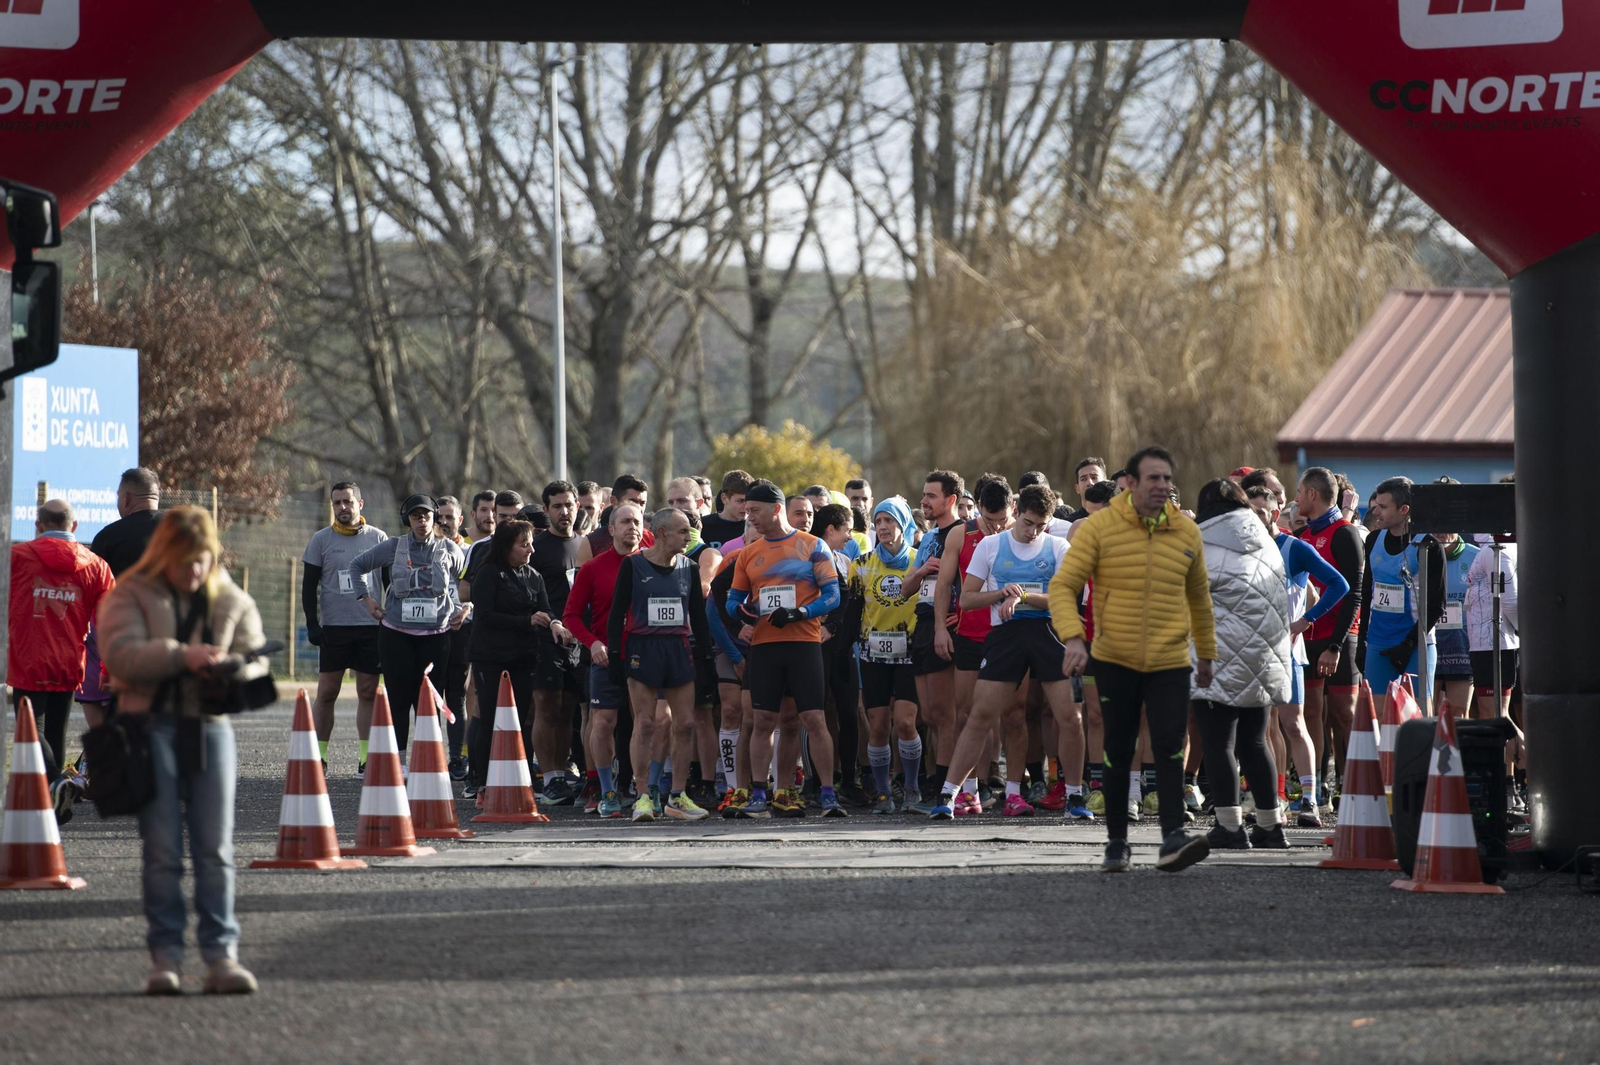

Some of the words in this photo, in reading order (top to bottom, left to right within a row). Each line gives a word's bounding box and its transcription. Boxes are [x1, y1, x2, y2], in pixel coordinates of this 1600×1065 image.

[0, 77, 127, 115] ORTE
[1369, 71, 1600, 114] CCNORTE
[36, 118, 90, 131] EVENTS
[1431, 119, 1458, 131] FOR
[1462, 119, 1520, 132] SPORTS
[1521, 116, 1581, 131] EVENTS
[51, 385, 100, 415] XUNTA
[51, 419, 69, 446] DE
[72, 420, 129, 449] GALICIA
[14, 506, 26, 520] DO
[33, 587, 76, 602] #TEAM
[768, 595, 781, 608] 26
[1379, 592, 1390, 606] 24
[412, 606, 425, 618] 171
[657, 607, 675, 620] 189
[879, 640, 893, 653] 38
[721, 738, 737, 773] eleven
